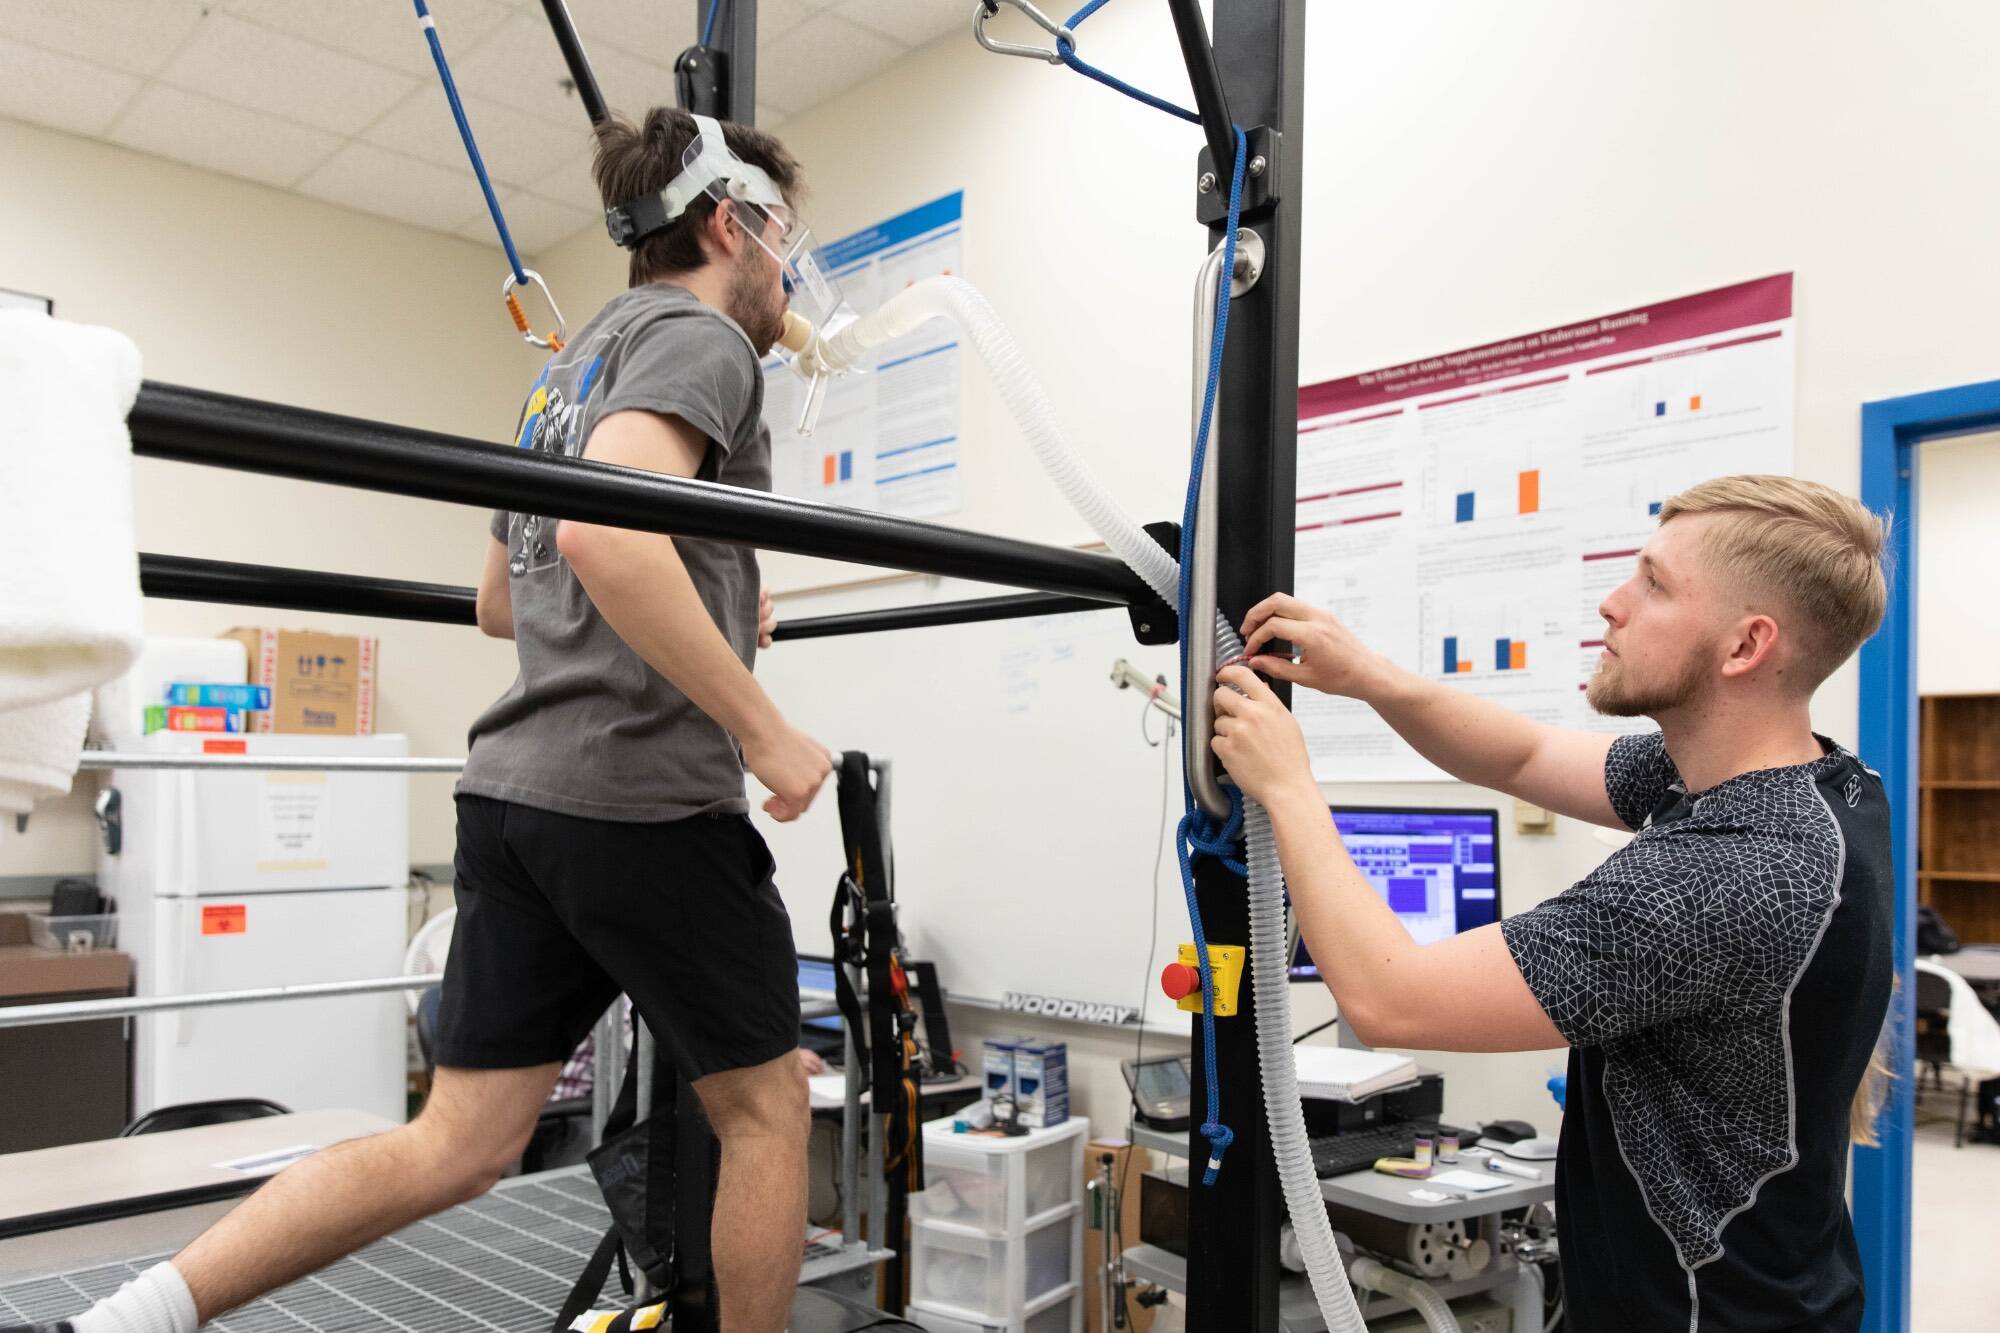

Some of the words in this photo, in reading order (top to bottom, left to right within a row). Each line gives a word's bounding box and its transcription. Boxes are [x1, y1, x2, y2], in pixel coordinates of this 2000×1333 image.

[1358, 374, 1375, 386] The
[1443, 340, 1526, 366] Supplementation
[1526, 338, 1540, 349] on
[1540, 325, 1598, 344] Endurance
[1600, 312, 1649, 333] Running
[1001, 991, 1131, 1025] WOODWAY
